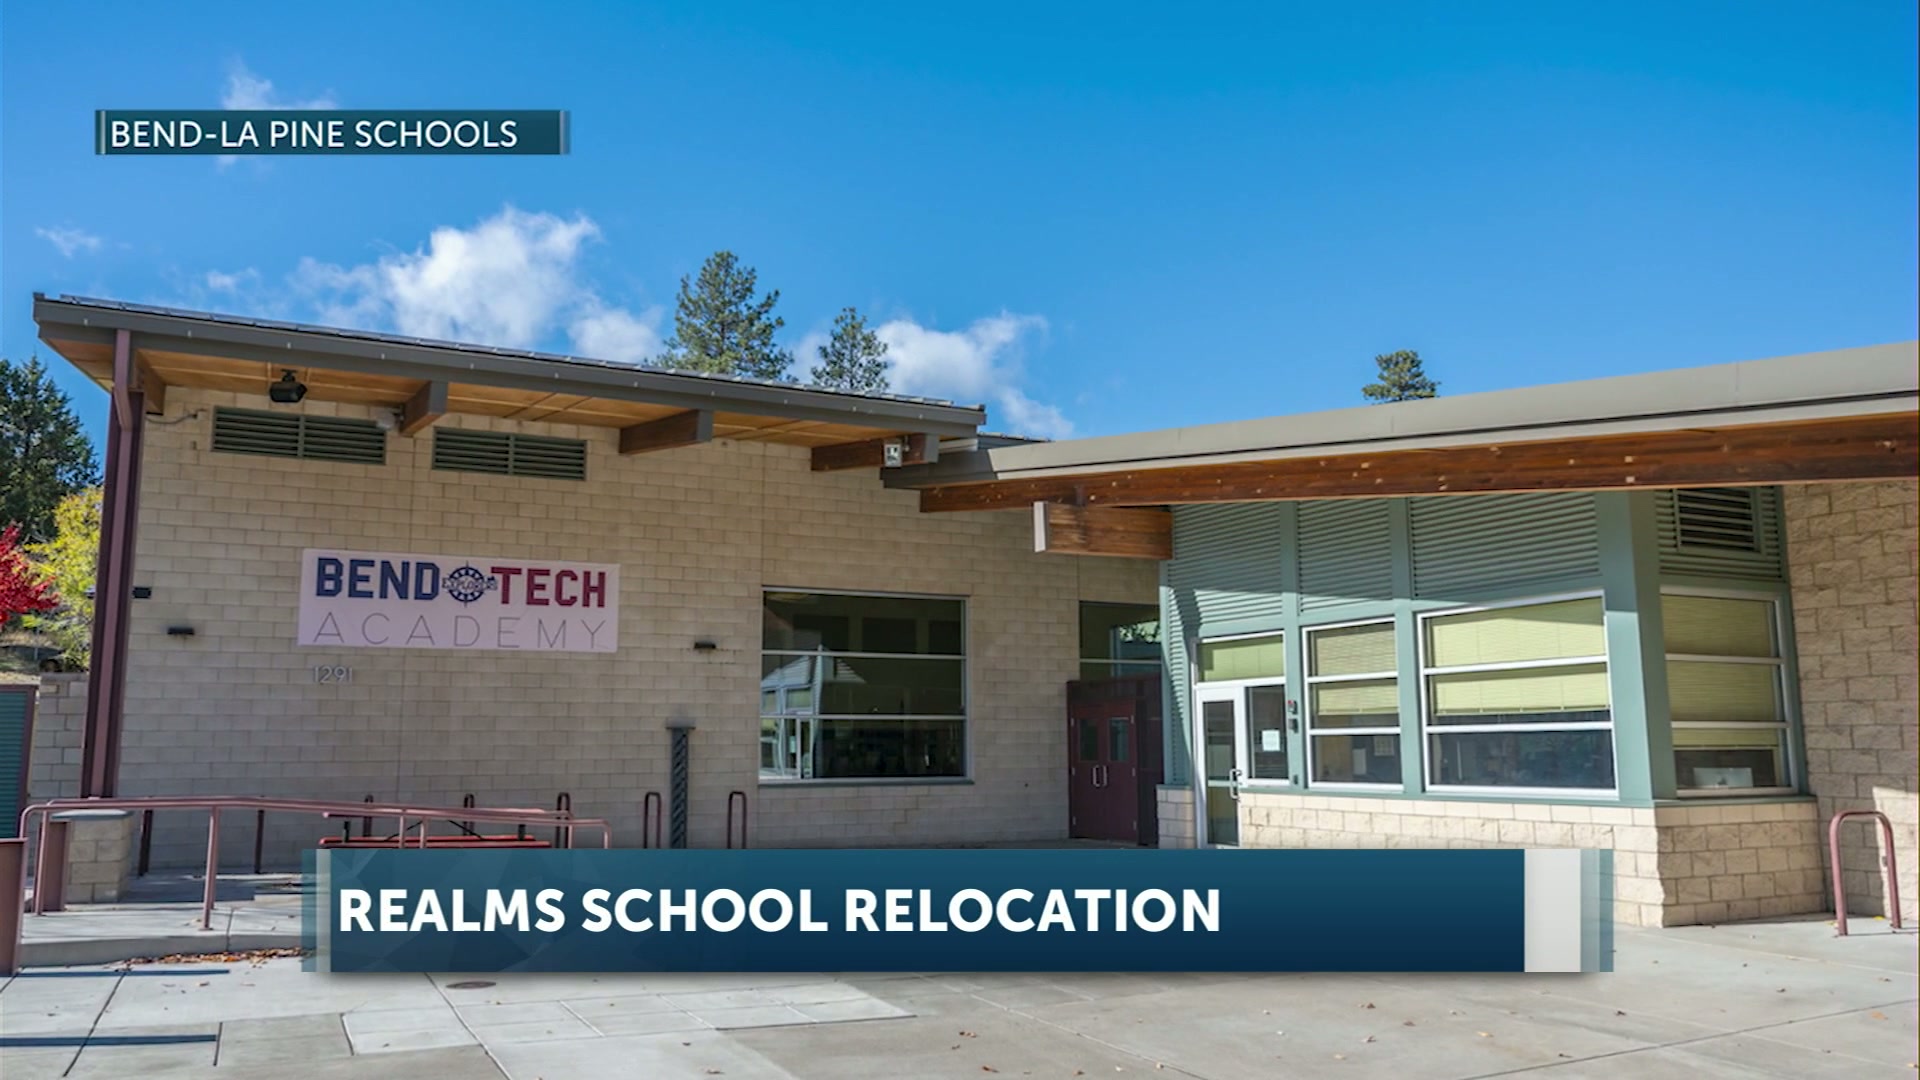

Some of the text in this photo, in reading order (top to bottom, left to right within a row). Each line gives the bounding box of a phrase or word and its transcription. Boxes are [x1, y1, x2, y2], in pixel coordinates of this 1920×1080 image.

[315, 557, 606, 608] BEND TECH
[313, 611, 606, 648] ACADEMY
[313, 665, 353, 684] 1291
